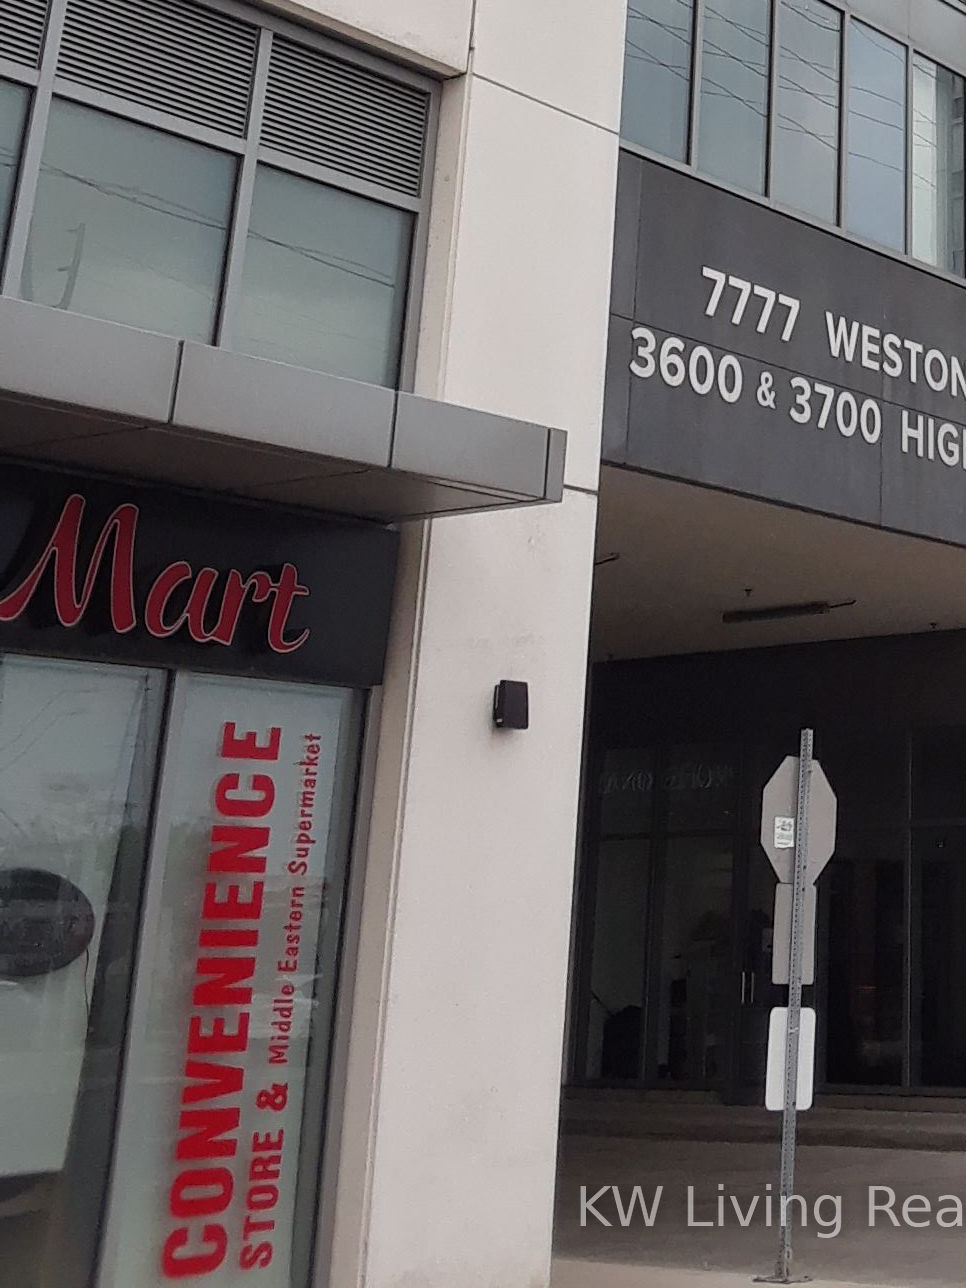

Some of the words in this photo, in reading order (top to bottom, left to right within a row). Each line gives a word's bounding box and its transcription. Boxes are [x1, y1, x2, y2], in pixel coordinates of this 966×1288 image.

[702, 266, 800, 342] 7777
[629, 327, 742, 404] 3600
[756, 371, 776, 409] &
[789, 376, 882, 445] 3700
[0, 494, 310, 654] Mart
[287, 732, 322, 876] Supermarket
[277, 886, 305, 972] Eastern
[162, 722, 282, 1279] CONVENIENCE
[268, 984, 295, 1065] Middle
[256, 1082, 289, 1112] &
[239, 1128, 284, 1271] STORE
